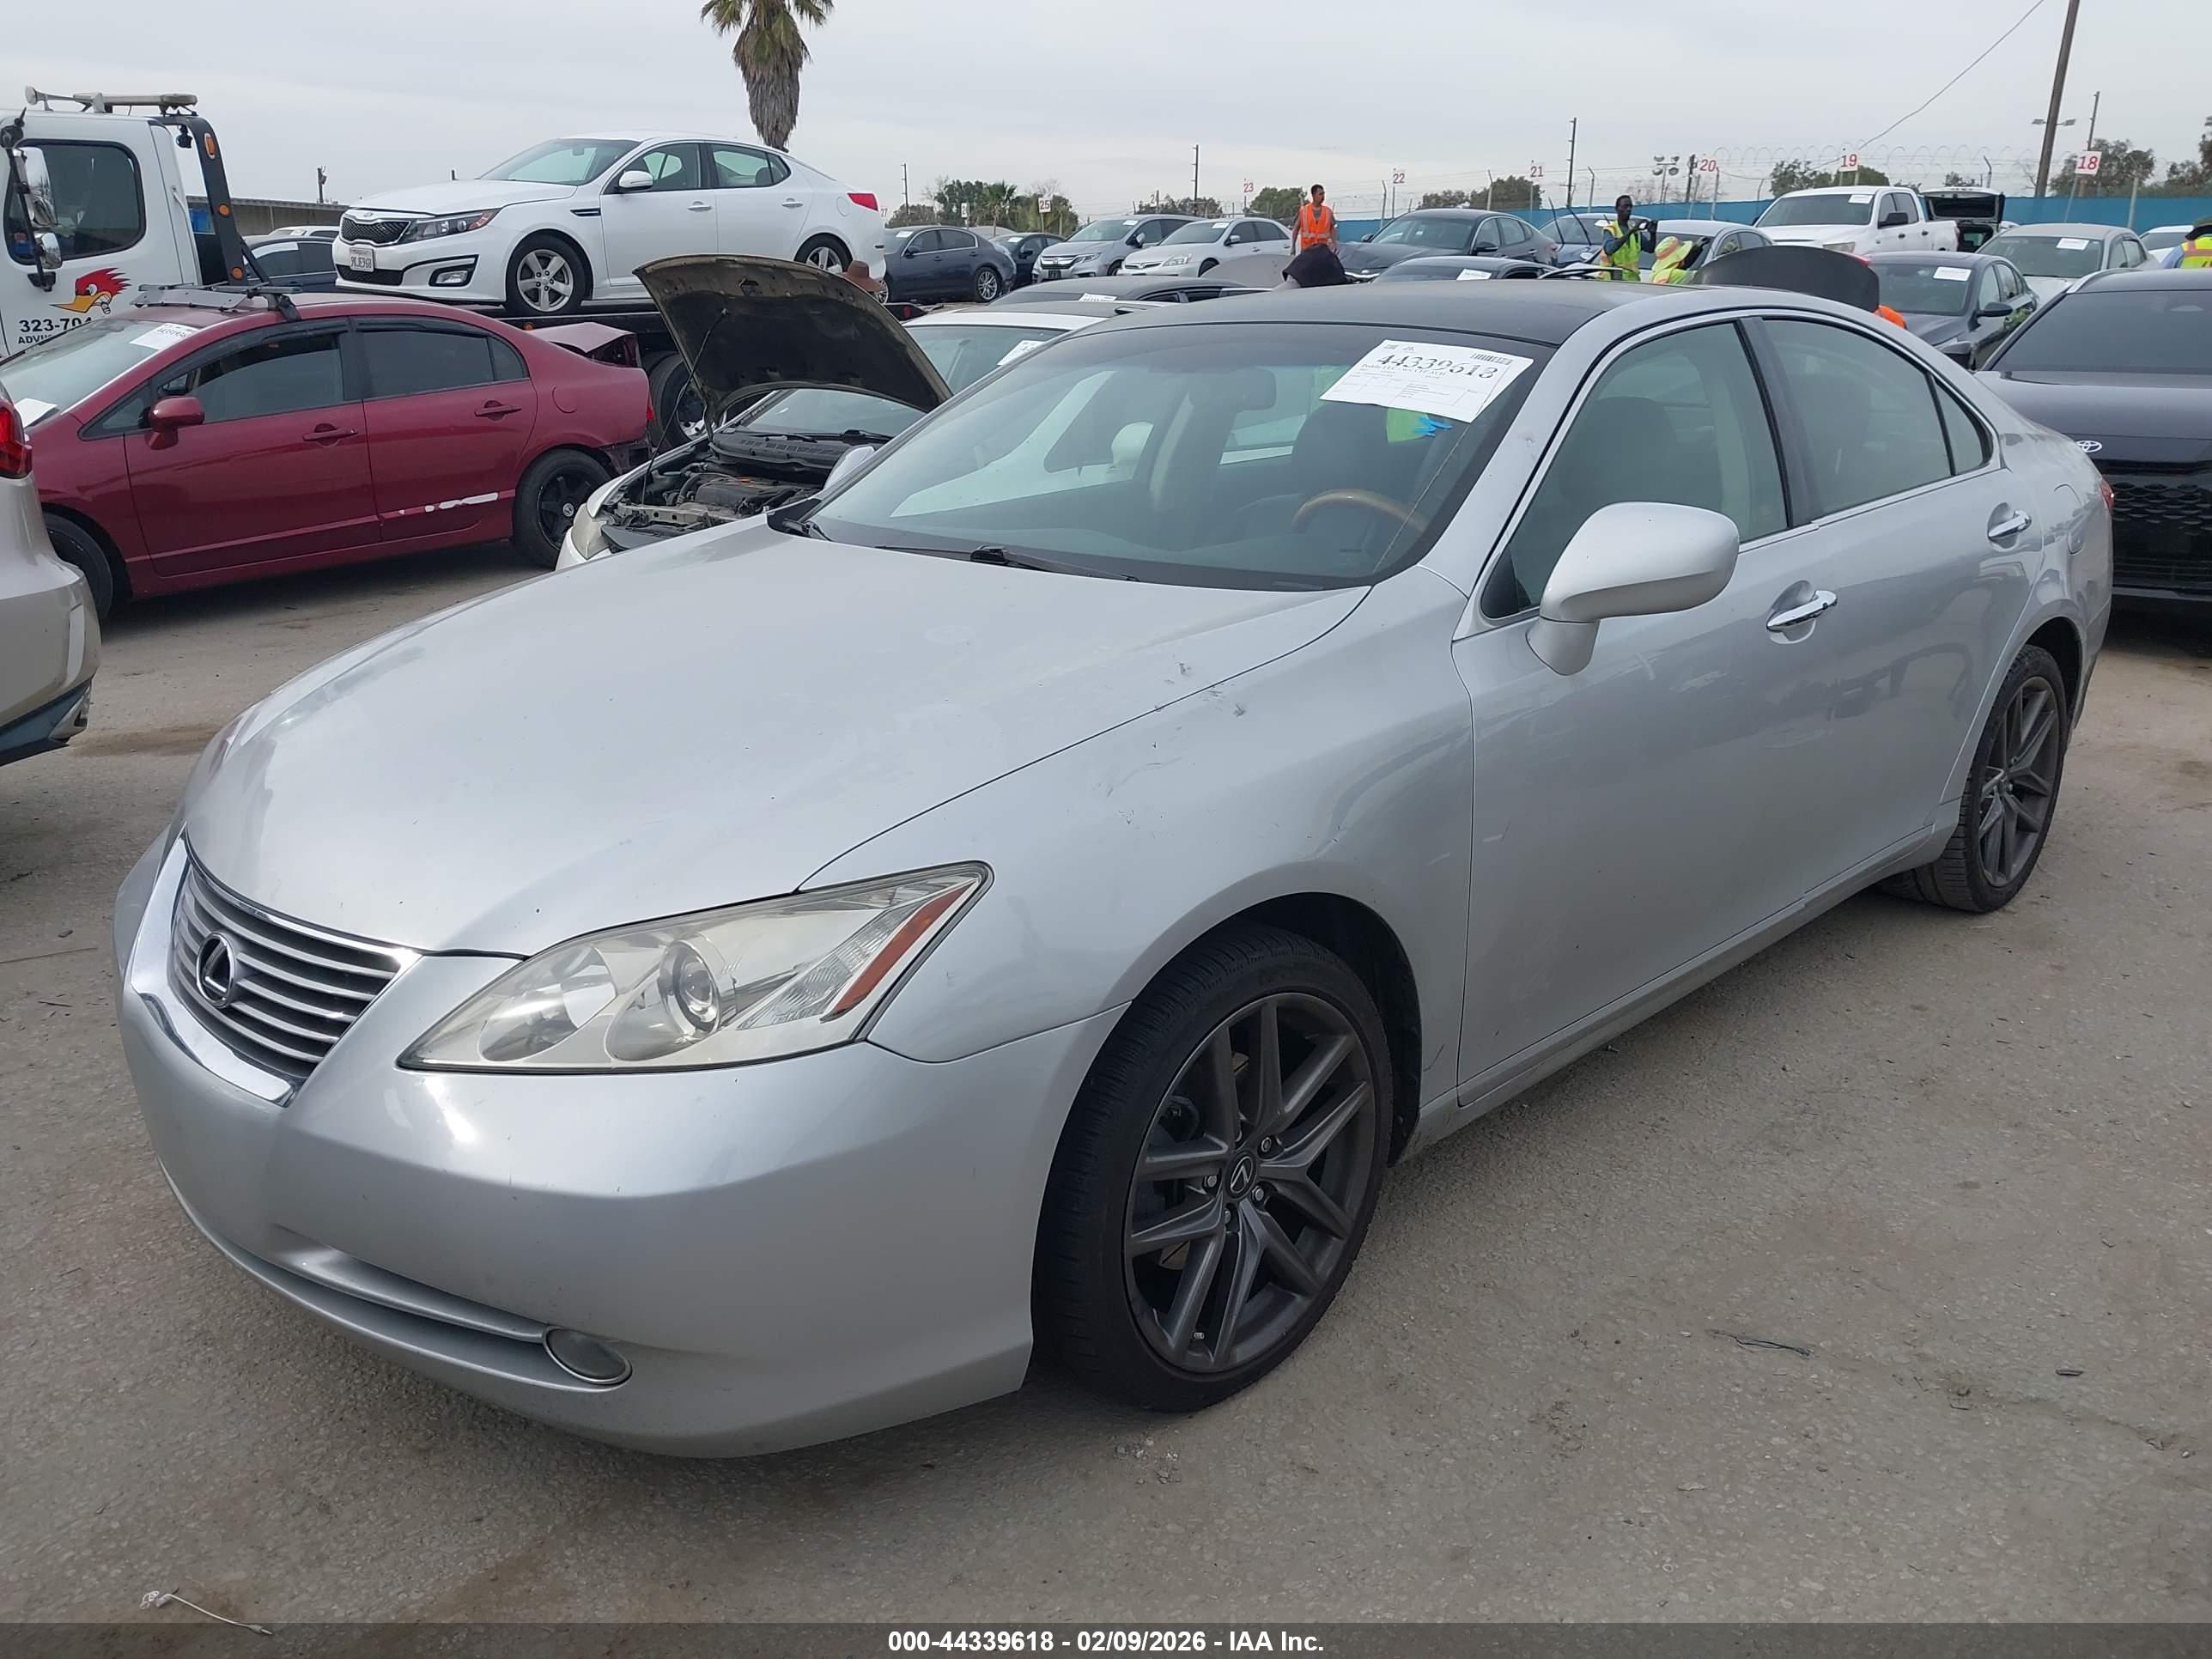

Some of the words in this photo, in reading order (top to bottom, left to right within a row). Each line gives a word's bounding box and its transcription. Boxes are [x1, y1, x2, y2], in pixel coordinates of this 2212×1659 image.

[1699, 159, 1717, 172] 20
[1841, 154, 1857, 167] 19
[2077, 155, 2099, 170] 18
[1530, 166, 1544, 178] 21
[1393, 173, 1405, 184] 22
[1243, 182, 1254, 193] 23
[1039, 200, 1050, 210] 25
